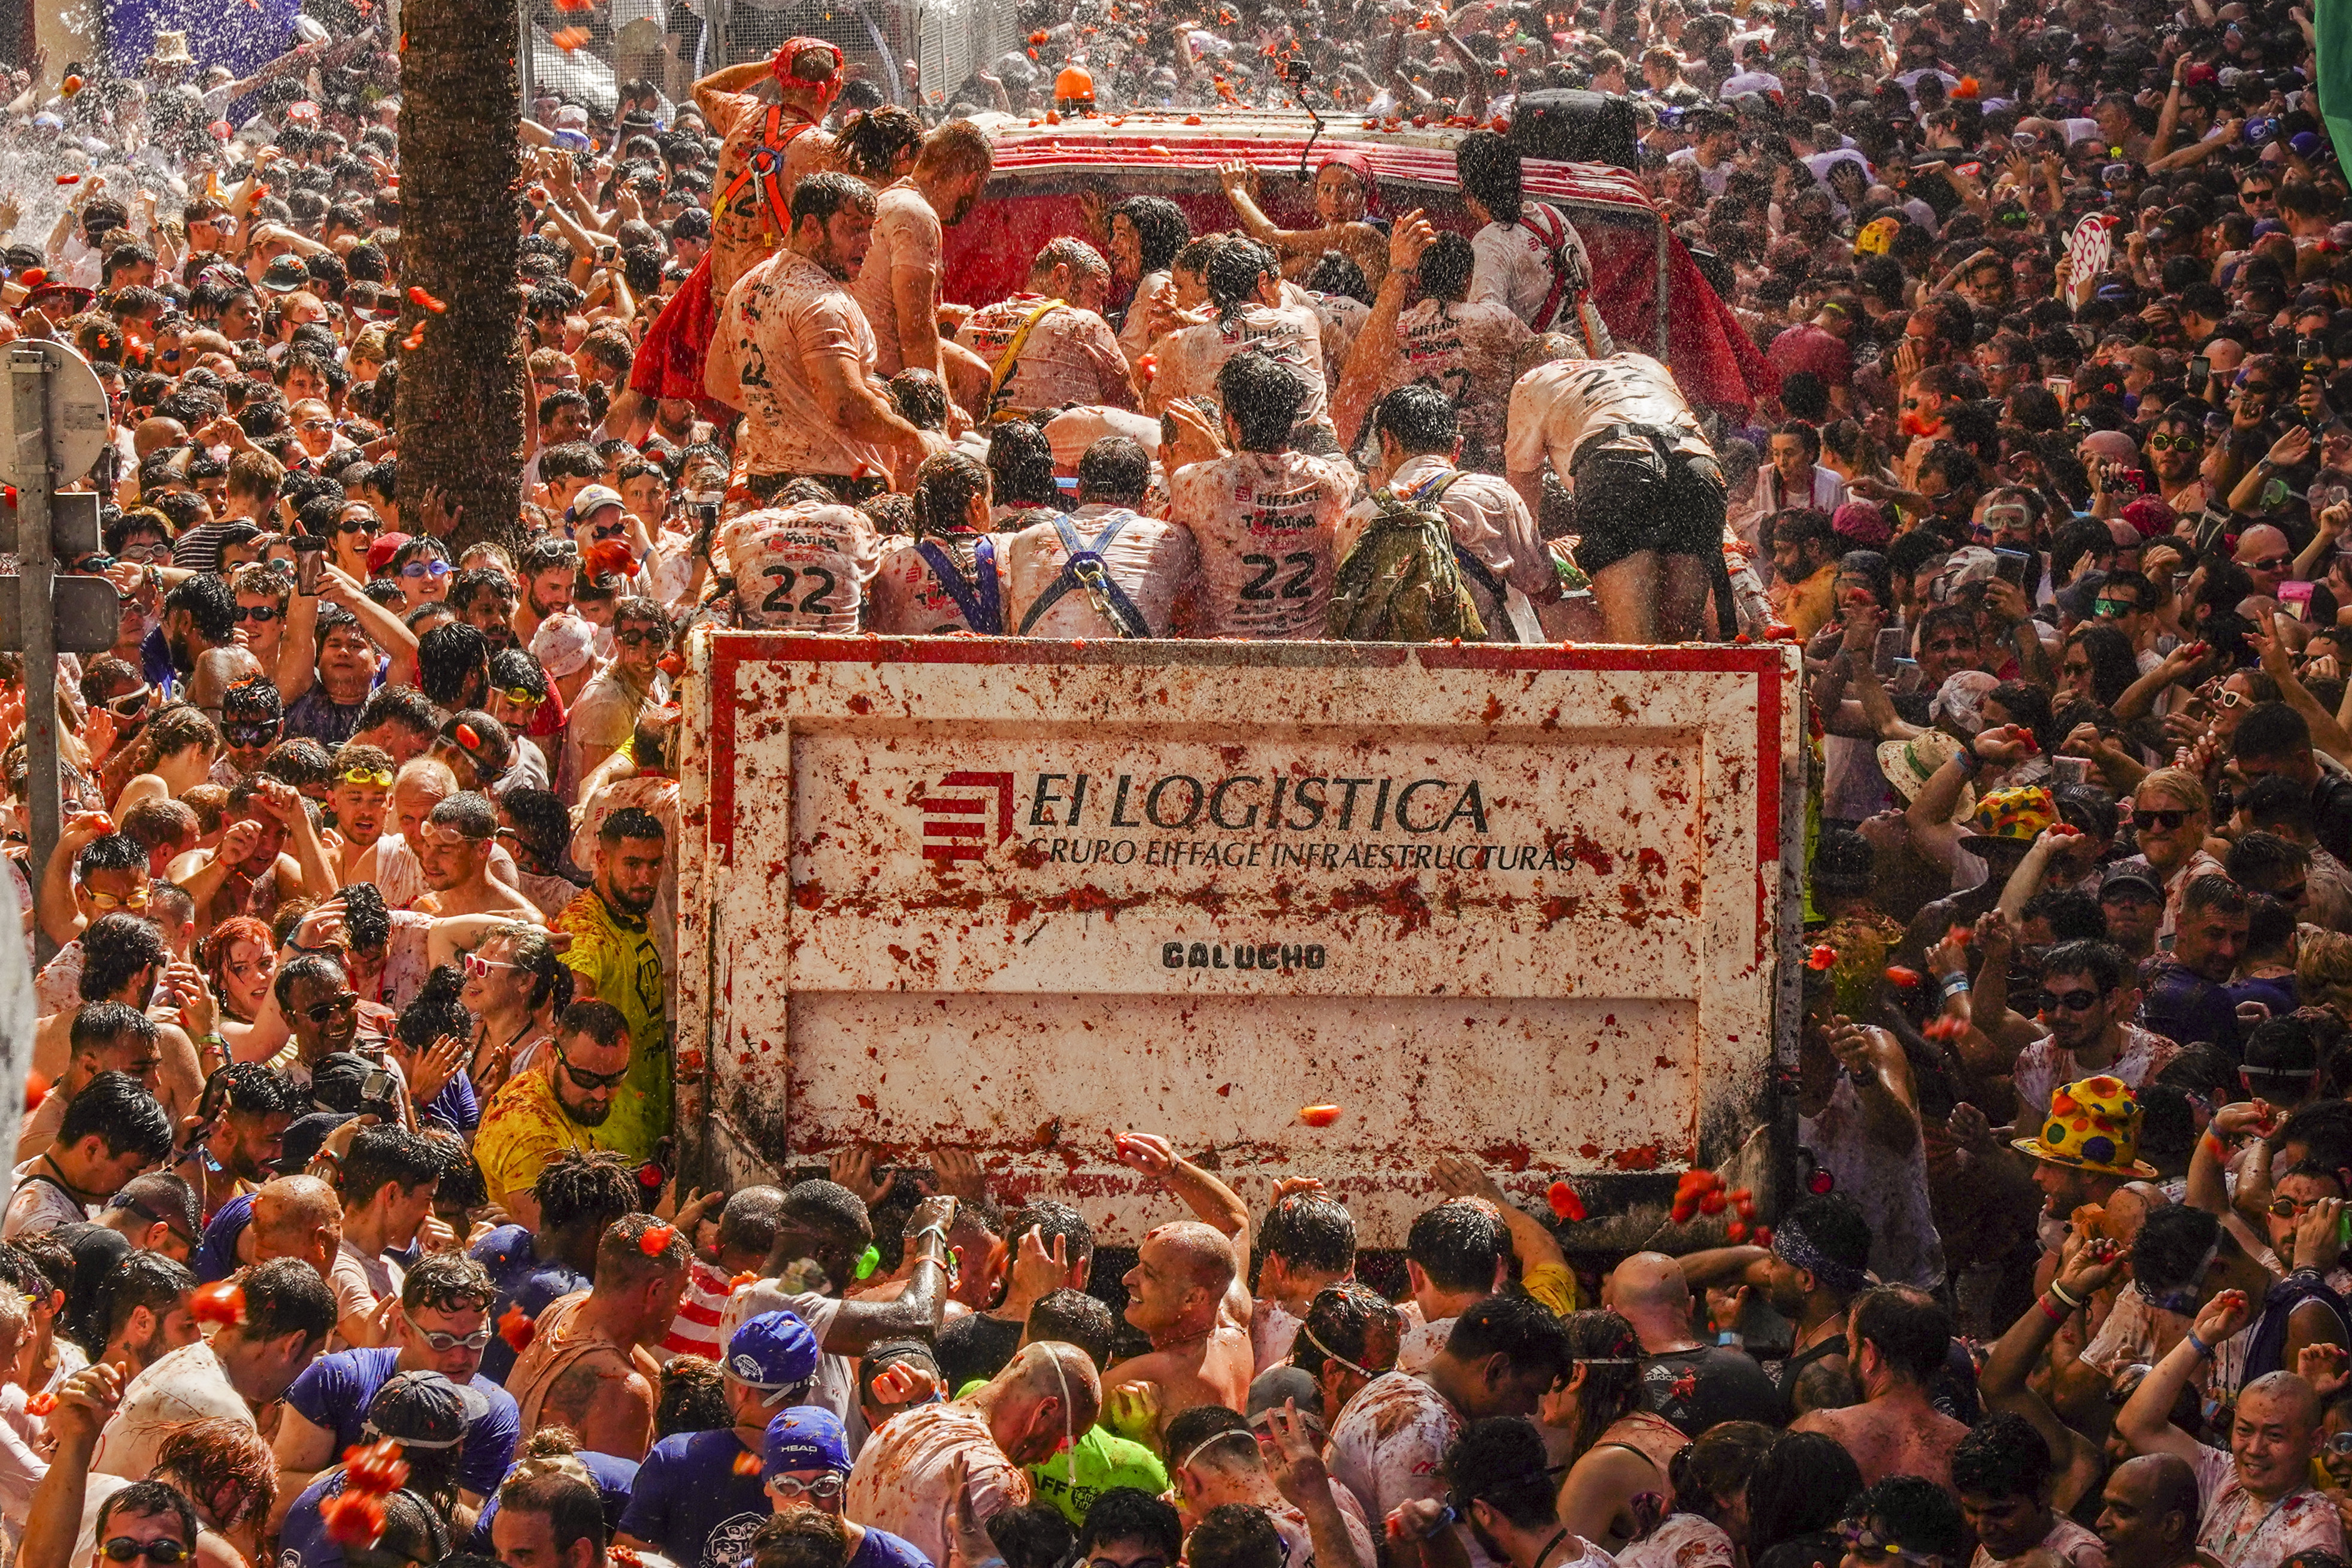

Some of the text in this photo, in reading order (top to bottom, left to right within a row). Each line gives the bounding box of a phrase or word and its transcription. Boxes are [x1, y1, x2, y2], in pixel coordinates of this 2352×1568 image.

[1257, 489, 1322, 507] EIFFAGE
[762, 565, 836, 615] 22
[1240, 551, 1316, 600] 22
[1029, 773, 1489, 834] EI LOGISTICA
[1145, 840, 1261, 868] EIFFAGE
[1270, 842, 1577, 872] INFRAESTRUCTURAS
[1162, 942, 1325, 969] GALUCHO
[1644, 1373, 1679, 1382] adidas
[781, 1445, 818, 1453] HEAD
